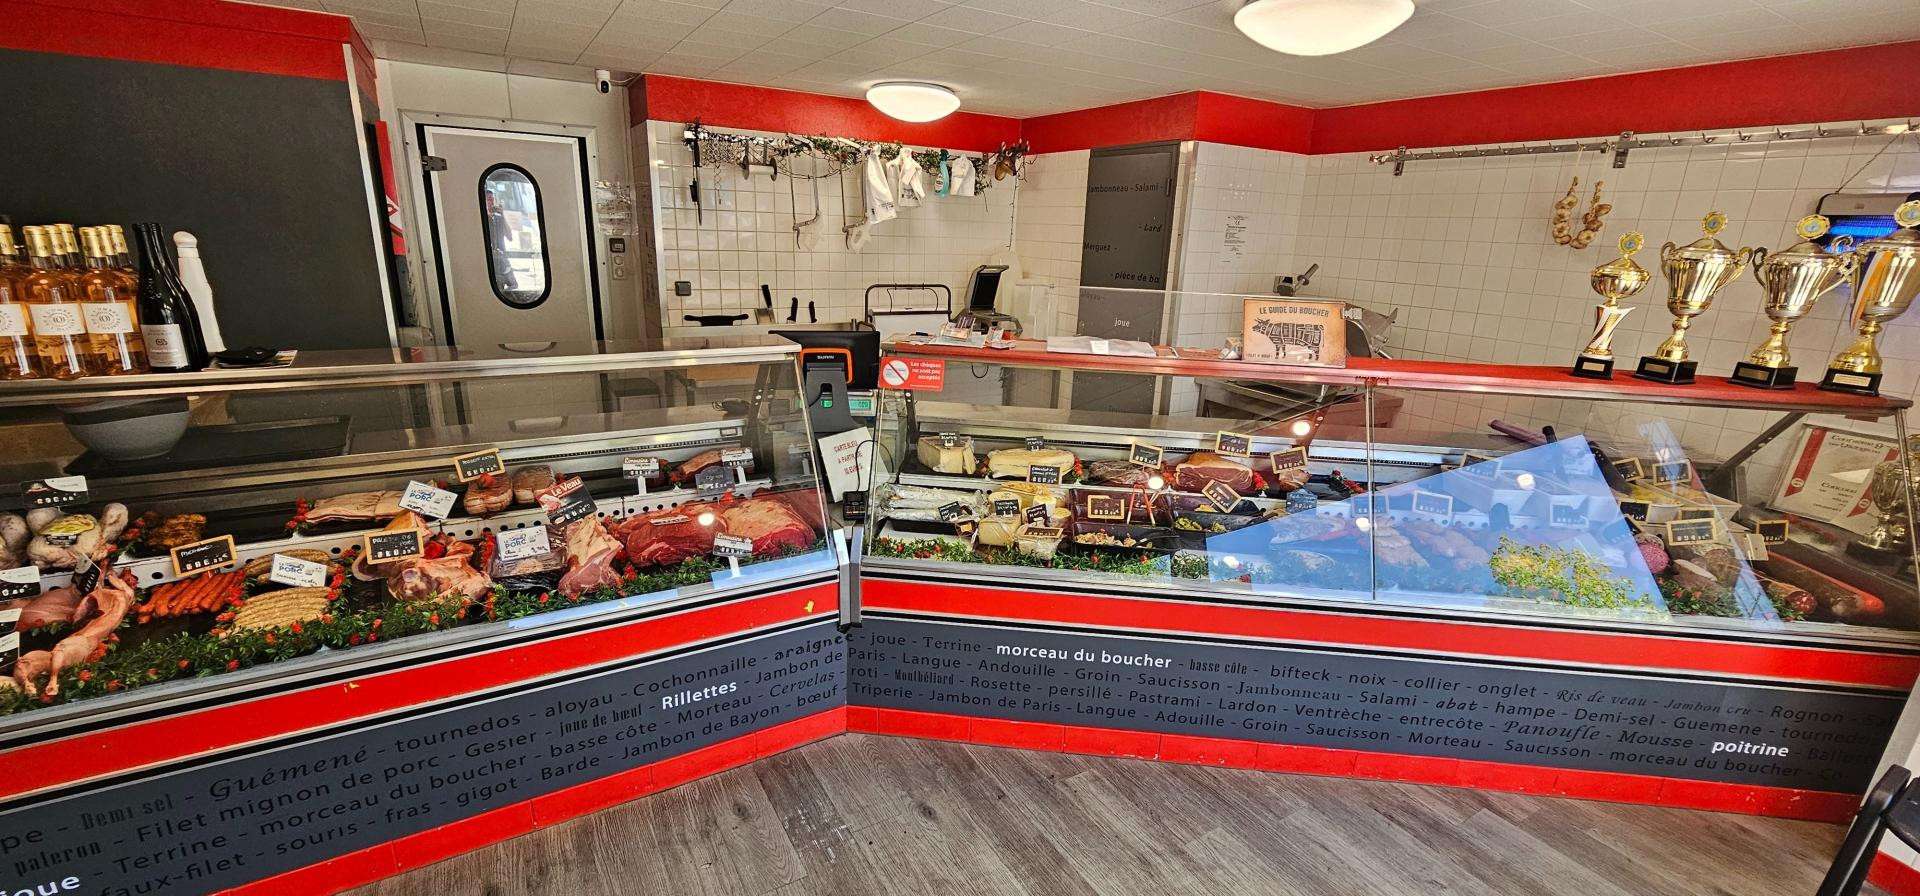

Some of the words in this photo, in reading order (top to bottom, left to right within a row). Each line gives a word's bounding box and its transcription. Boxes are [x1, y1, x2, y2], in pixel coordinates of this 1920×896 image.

[551, 486, 563, 498] Le
[561, 477, 582, 492] Veau
[505, 538, 527, 549] PORC
[848, 648, 886, 664] Paris
[903, 653, 961, 671] Langue
[978, 659, 1056, 677] Andouille
[1076, 668, 1120, 683] Groin
[1137, 672, 1220, 691] Saucisson
[1235, 681, 1341, 700] Jambonneau
[1359, 691, 1417, 708] Salami
[1436, 698, 1477, 712] abat
[1495, 702, 1555, 720] hampe
[1575, 708, 1655, 727] Demi-sel
[870, 633, 906, 651] joue
[923, 636, 981, 652] Terrine
[996, 643, 1068, 660] morceau
[1074, 648, 1095, 662] du
[1102, 650, 1171, 669] boucher
[1189, 659, 1219, 673] basse
[1270, 665, 1330, 681] bifteck
[1349, 672, 1385, 686] noix
[1405, 676, 1460, 691] collier
[1478, 682, 1536, 699] onglet
[1557, 688, 1583, 703] Ris
[1587, 690, 1604, 703] de
[1611, 695, 1647, 707] veau
[1664, 698, 1720, 714] Jambon
[1771, 705, 1843, 728] Rognon
[970, 676, 1031, 693] Rosette
[1049, 683, 1112, 701] persillé
[1129, 690, 1201, 707] Pastrami
[1219, 699, 1276, 714] Lardon
[1294, 704, 1381, 722] Ventrèche
[1400, 713, 1484, 731] entrecôte
[1503, 720, 1600, 743] Panoufle
[1618, 730, 1693, 749] Mousse
[1711, 740, 1789, 758] poitrine
[112, 833, 228, 875] Terrine
[259, 791, 379, 835] morceau
[390, 780, 419, 801] du
[430, 752, 527, 790] boucher
[550, 733, 608, 758] basse
[615, 718, 657, 742] côte
[677, 696, 752, 724] Morteau
[769, 670, 835, 699] Cervelas
[138, 812, 208, 844] Filet
[219, 782, 330, 825] mignon
[342, 770, 374, 790] de
[384, 755, 440, 786] porc
[560, 718, 588, 739] joue
[593, 714, 607, 730] de
[661, 680, 737, 712] Rillettes
[755, 659, 820, 685] Jambon
[824, 653, 843, 669] de
[144, 793, 176, 818] sel
[209, 746, 368, 802] Guémené
[395, 712, 520, 753] tournedos
[545, 693, 613, 719] aloyau
[634, 656, 757, 695] Cochonnaille
[275, 823, 358, 856] souris
[385, 802, 431, 829] fras
[457, 776, 518, 808] gigot
[541, 754, 599, 781] Barde
[620, 731, 696, 761] Jambon
[701, 721, 724, 737] de
[730, 704, 780, 730] Bayon
[797, 686, 837, 708] bœuf
[852, 682, 914, 700] Triperie
[929, 690, 991, 706] Jambon
[998, 697, 1017, 708] de
[1023, 698, 1060, 713] Paris
[1076, 703, 1136, 721] Langue
[1155, 710, 1225, 727] Adouille
[1242, 718, 1288, 733] Groin
[1305, 723, 1390, 741] Saucisson
[1408, 732, 1480, 749] Morteau
[1504, 739, 1591, 758] Saucisson
[1610, 750, 1688, 767] morceau
[1694, 756, 1717, 769] du
[1724, 758, 1798, 777] boucher
